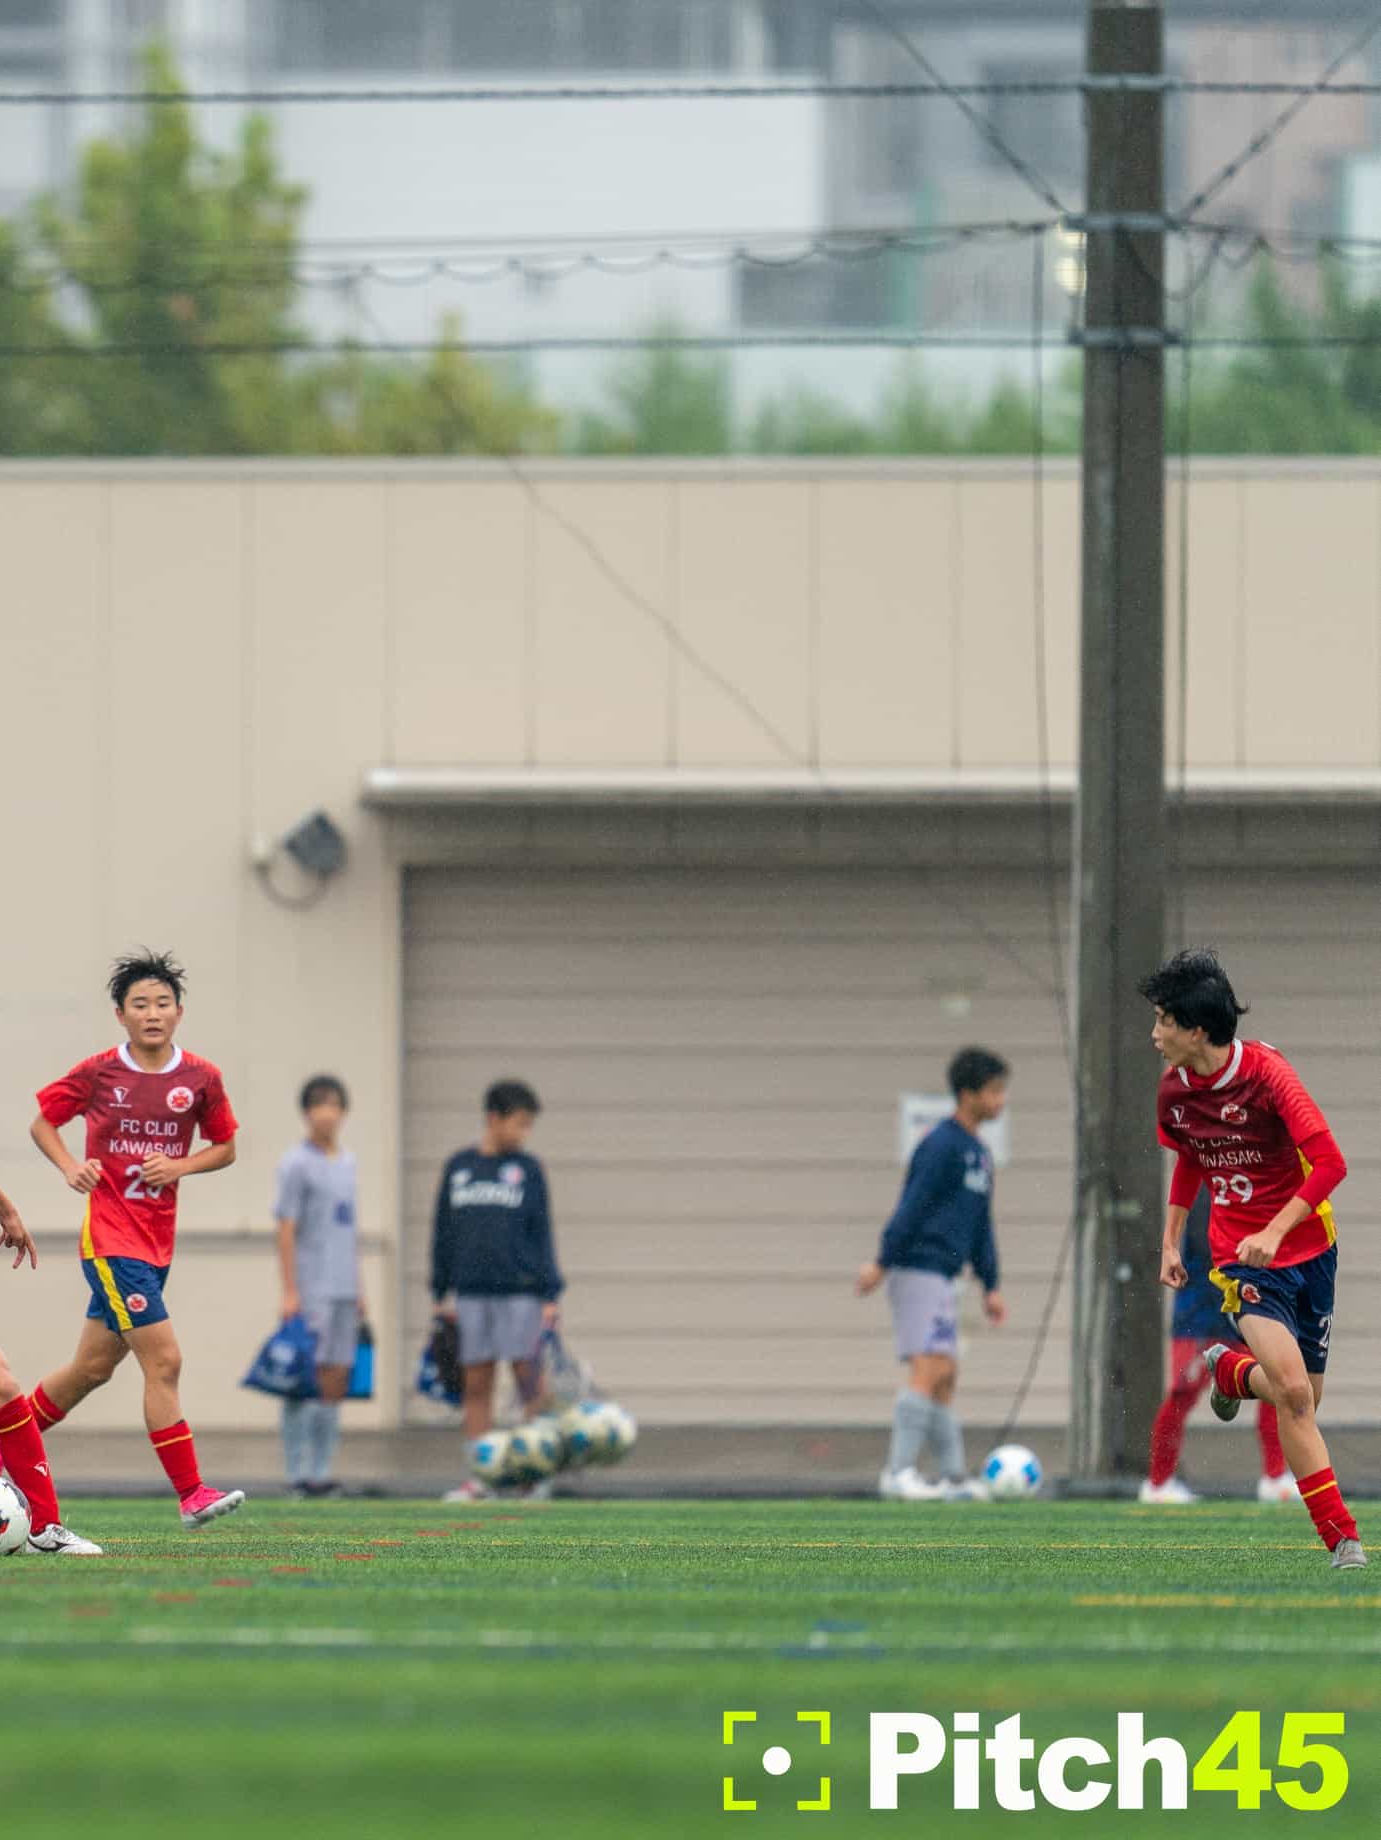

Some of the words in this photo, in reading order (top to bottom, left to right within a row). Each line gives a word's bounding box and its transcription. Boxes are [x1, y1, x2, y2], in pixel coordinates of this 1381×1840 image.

[120, 1119, 140, 1133] FC
[145, 1121, 179, 1136] CLIO
[109, 1139, 183, 1156] KAWASAKI
[1211, 1174, 1253, 1206] 29
